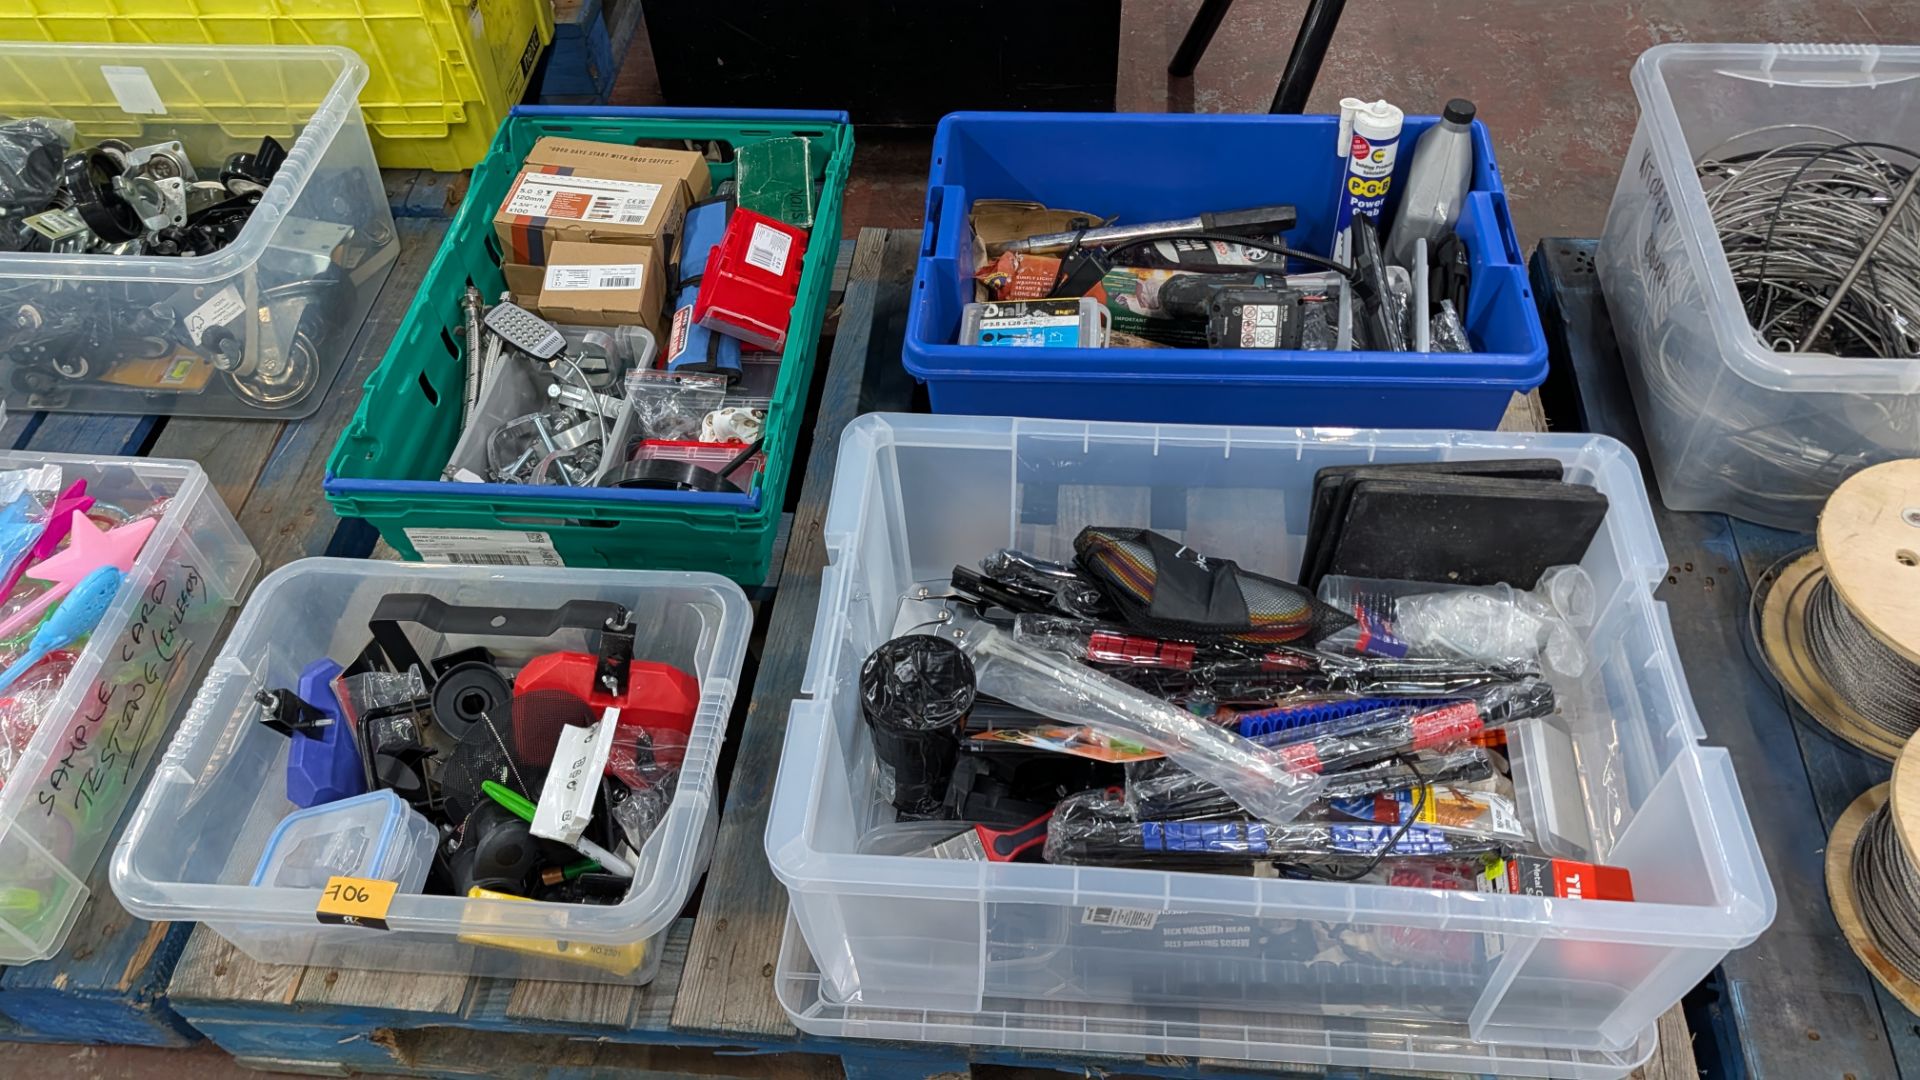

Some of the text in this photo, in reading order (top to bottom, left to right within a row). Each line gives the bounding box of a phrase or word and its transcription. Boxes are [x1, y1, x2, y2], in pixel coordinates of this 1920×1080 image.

[610, 153, 627, 161] WITH
[1350, 197, 1385, 208] Power
[39, 580, 167, 816] SAMPLE CARD
[74, 662, 160, 809] TESTING
[1533, 863, 1543, 888] Metal
[324, 884, 370, 903] 706
[1182, 925, 1224, 935] WASHER
